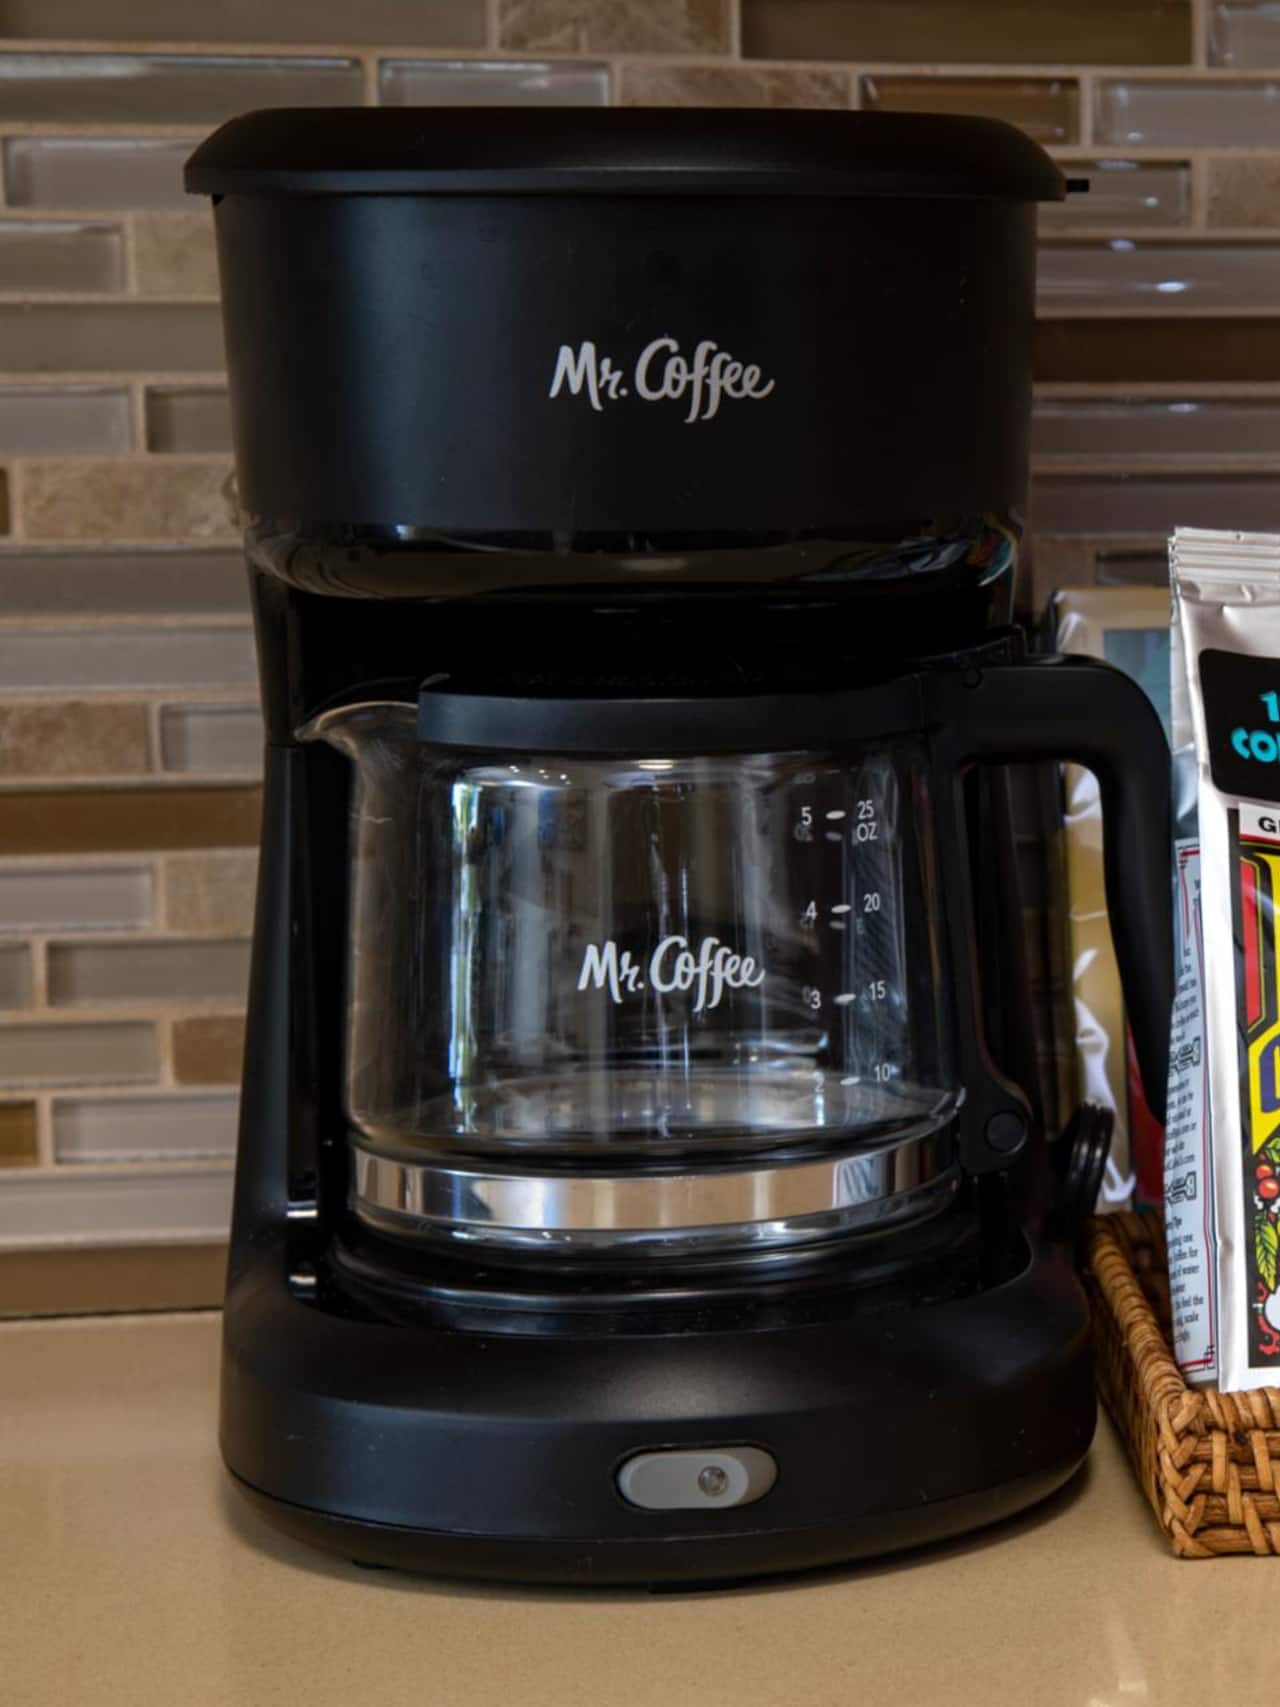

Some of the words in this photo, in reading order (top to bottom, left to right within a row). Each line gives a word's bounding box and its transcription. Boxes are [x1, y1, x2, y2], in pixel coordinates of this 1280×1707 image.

[549, 341, 628, 411] Mr.
[635, 338, 774, 423] Coffee
[801, 806, 812, 826] 5
[857, 799, 874, 820] 25
[856, 821, 878, 842] OZ
[806, 901, 817, 920] 4
[864, 893, 880, 912] 20
[577, 940, 645, 1004] Mr.
[650, 935, 766, 1013] Coffee
[810, 991, 822, 1010] 3
[869, 980, 887, 1001] 15
[874, 1064, 890, 1083] 10
